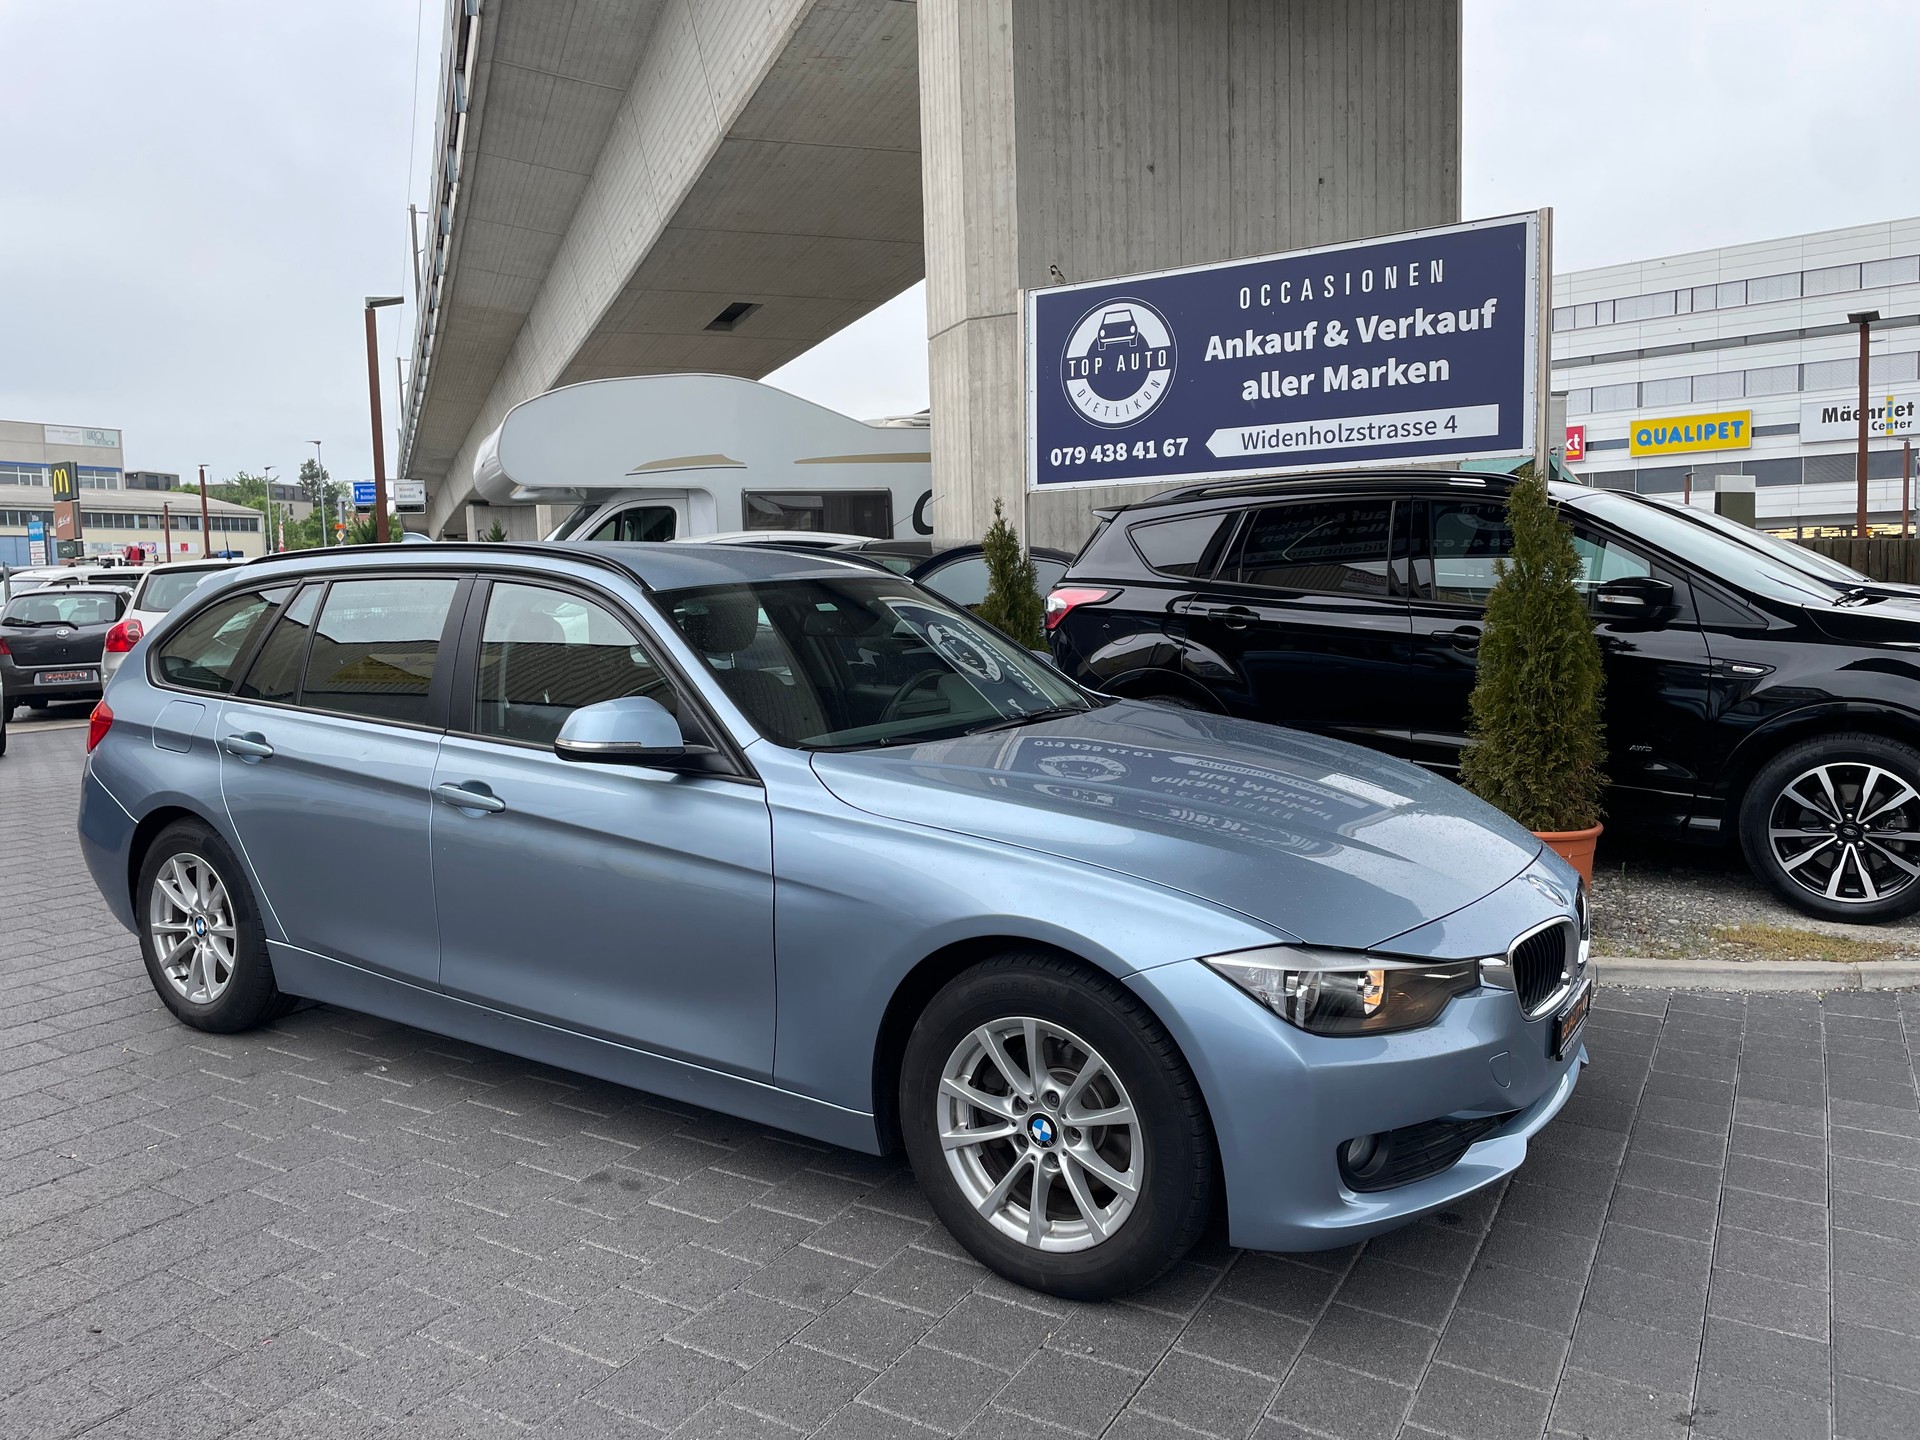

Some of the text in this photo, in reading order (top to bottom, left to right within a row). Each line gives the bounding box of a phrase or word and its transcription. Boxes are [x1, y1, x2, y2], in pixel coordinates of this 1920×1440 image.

[1239, 259, 1444, 310] OCCASIONEN
[1204, 297, 1498, 362] Ankauf & Verkauf
[1068, 349, 1168, 378] TOP AUTO
[1241, 357, 1450, 401] aller Marken
[1076, 378, 1161, 418] DIETLIKON
[1240, 413, 1458, 451] Widenholzstrasse 4
[1636, 420, 1744, 447] QUALIPET
[1871, 420, 1913, 431] Center
[1050, 437, 1189, 467] 079 438 41 67
